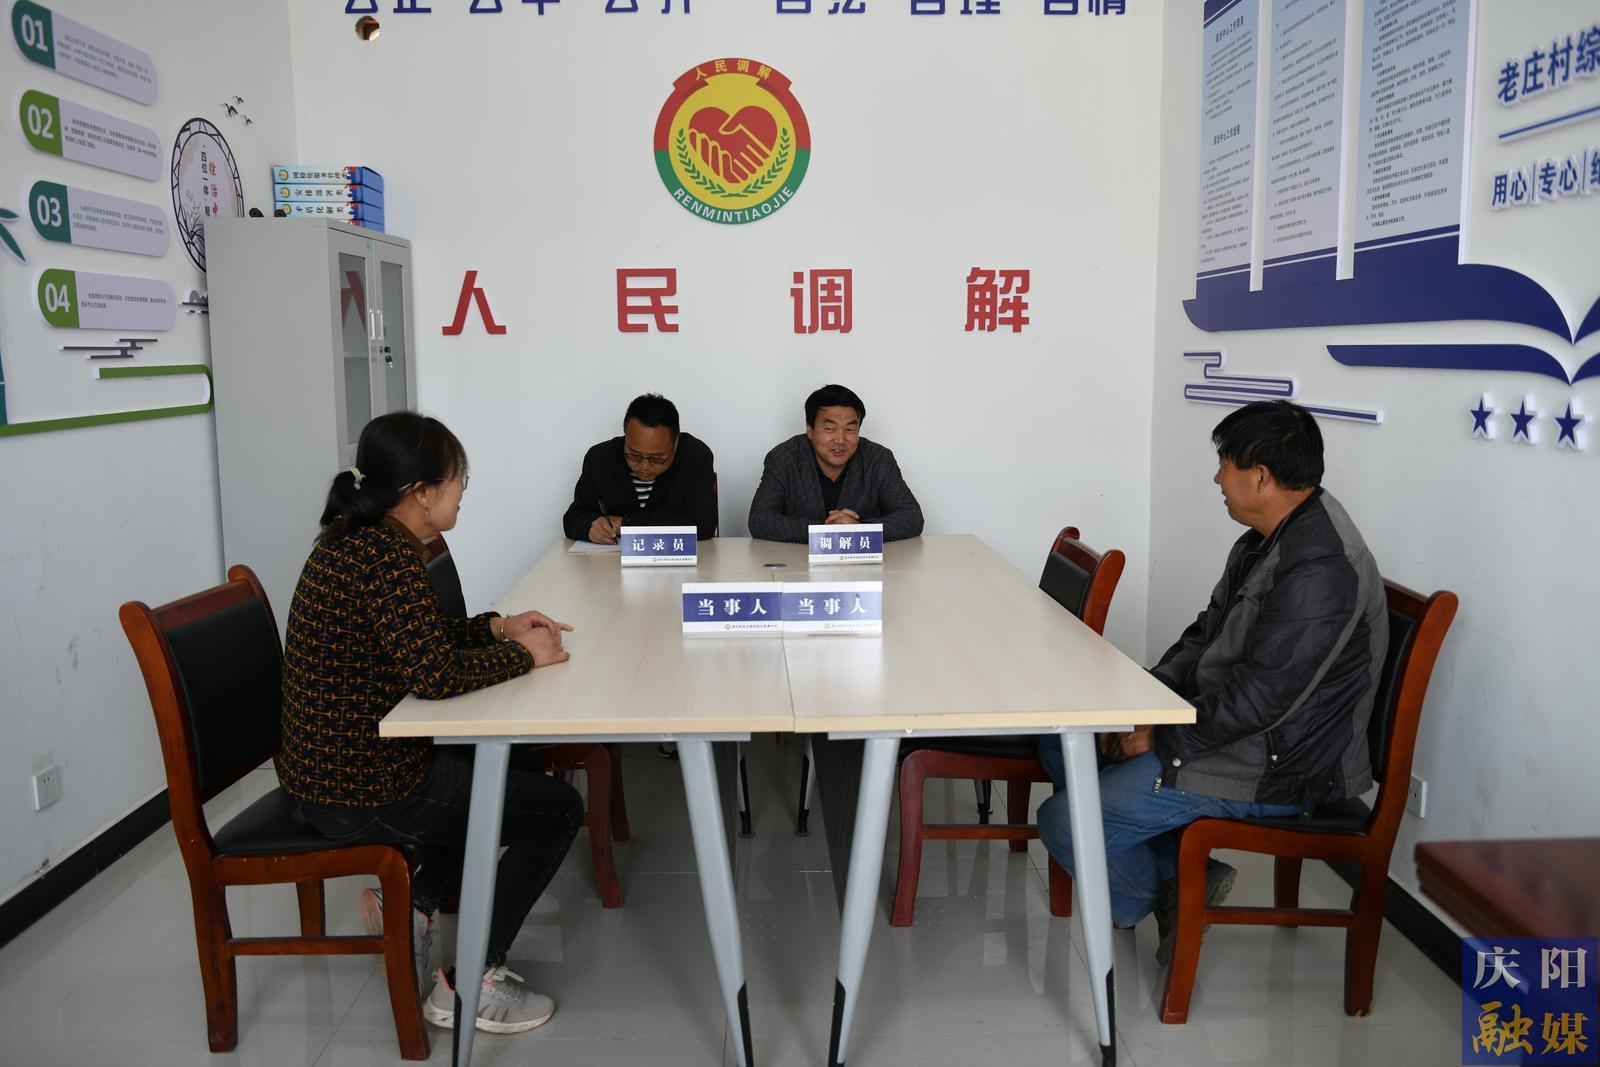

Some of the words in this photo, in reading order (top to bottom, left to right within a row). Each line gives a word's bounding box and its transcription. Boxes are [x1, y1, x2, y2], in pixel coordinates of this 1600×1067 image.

[21, 14, 49, 52] 01
[694, 59, 772, 81] 人民调解
[27, 104, 54, 140] 02
[36, 194, 63, 228] 03
[673, 186, 794, 223] RENMINTIAOJIE
[44, 282, 71, 313] 04
[442, 267, 1030, 335] 人民调解
[631, 538, 685, 552] 记录员
[819, 536, 871, 550] 调解员
[697, 598, 768, 616] 当事人
[797, 598, 867, 616] 当事人
